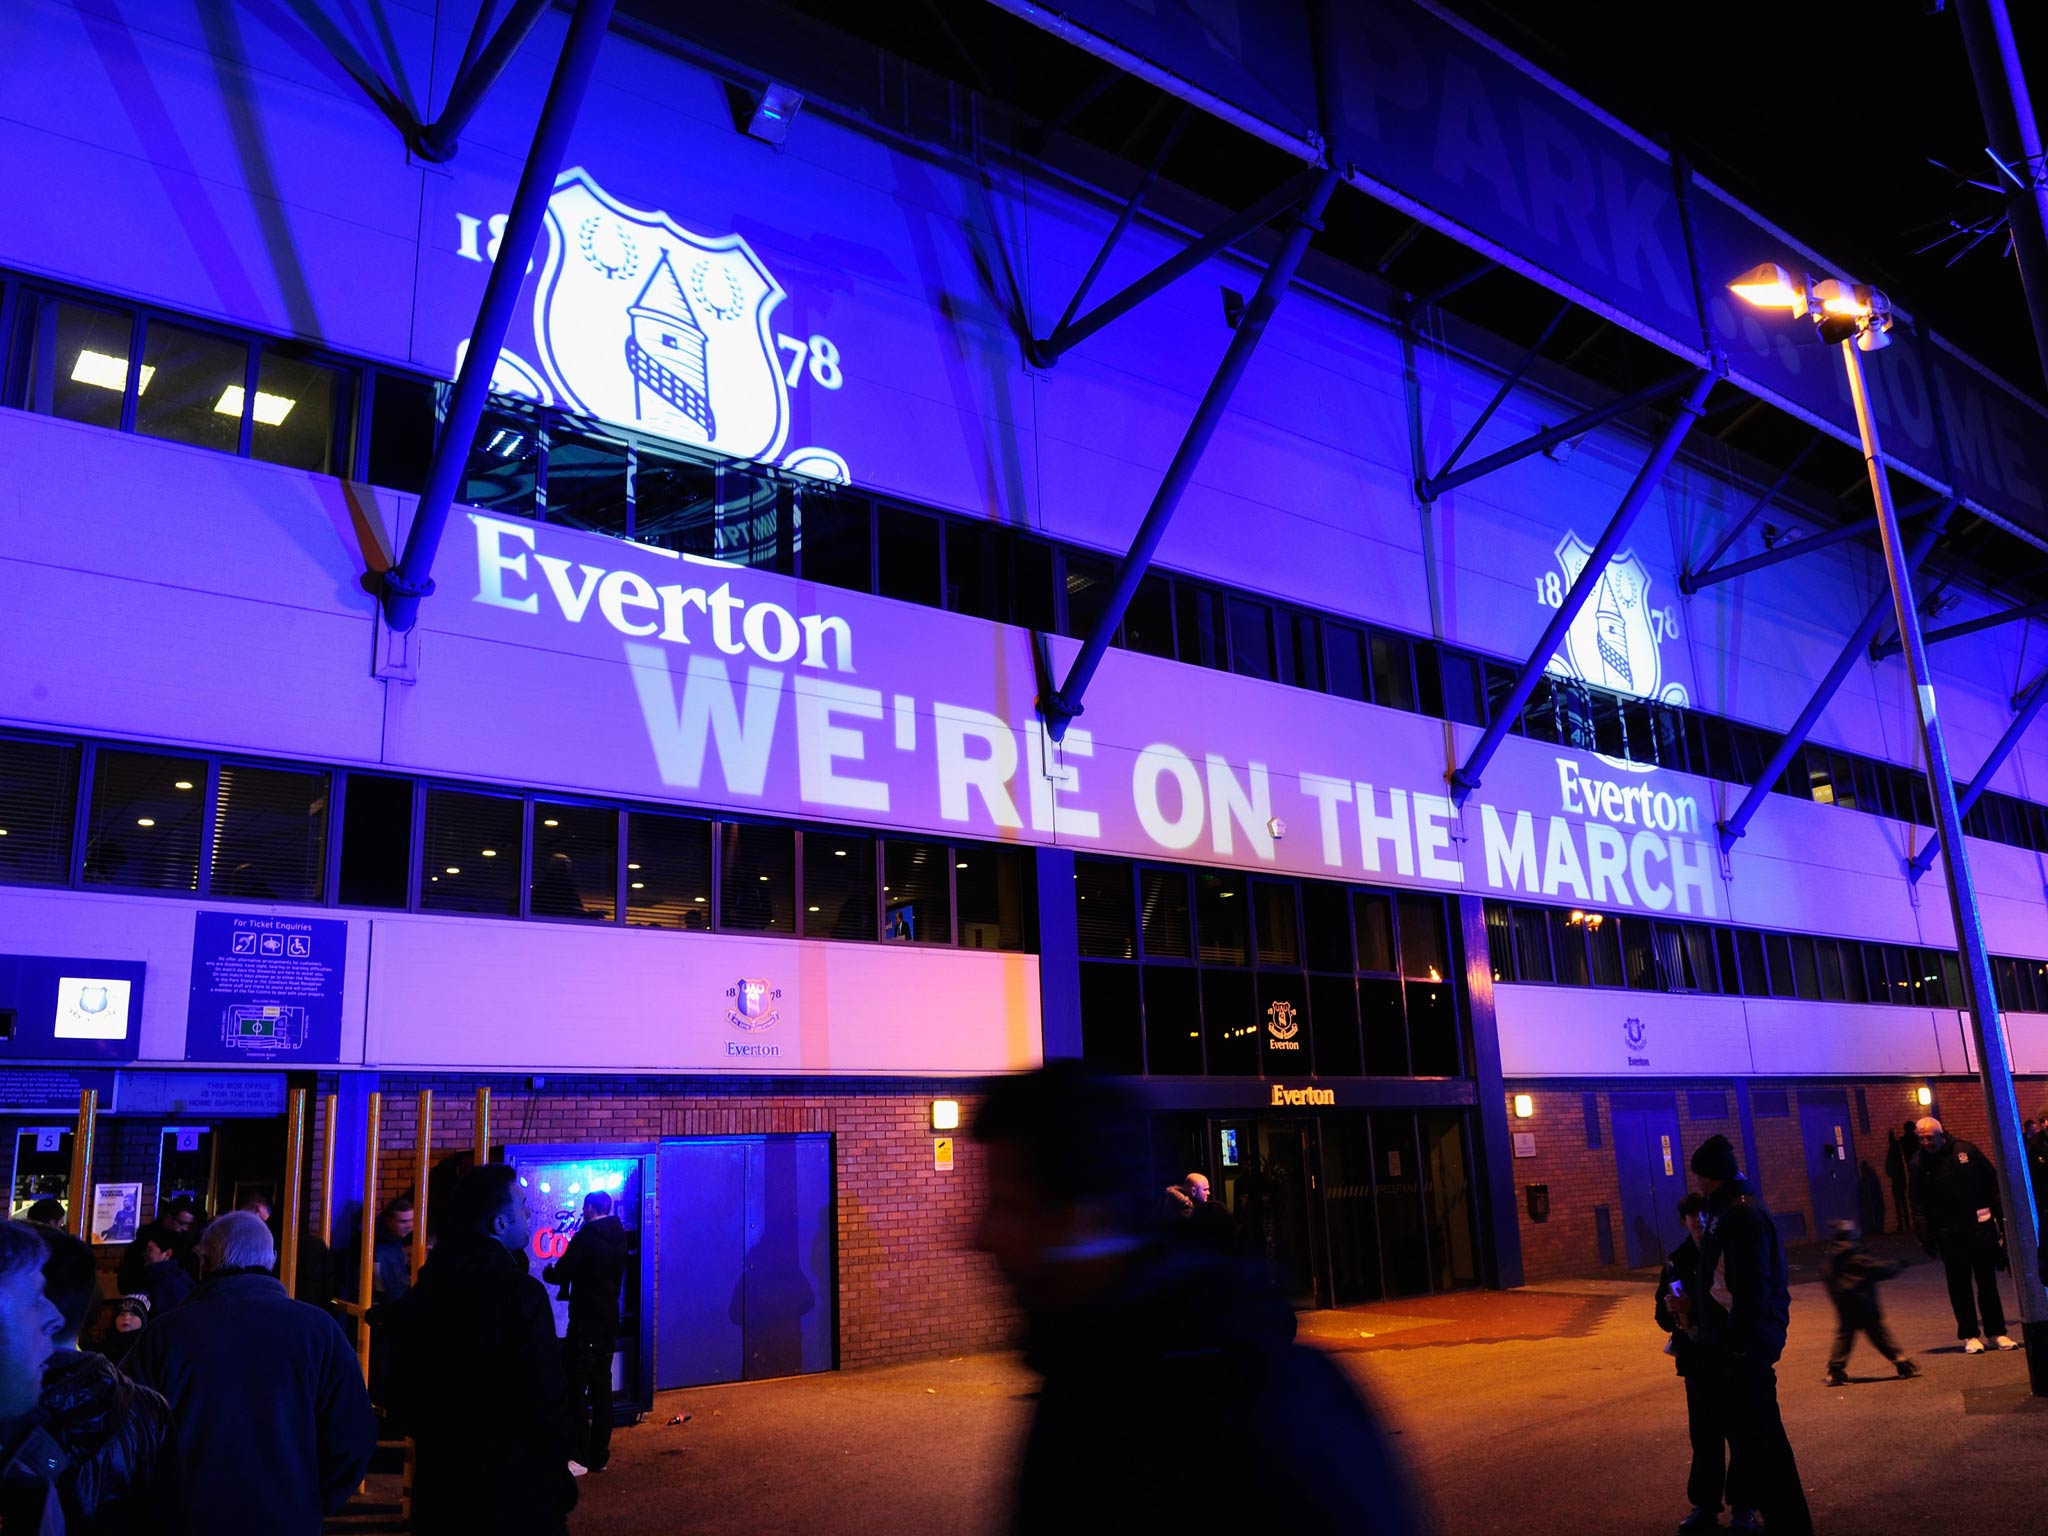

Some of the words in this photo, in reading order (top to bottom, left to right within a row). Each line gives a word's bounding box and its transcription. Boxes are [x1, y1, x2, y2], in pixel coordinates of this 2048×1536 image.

[778, 334, 843, 390] 78
[468, 513, 857, 675] Everton
[1535, 571, 1563, 609] 18
[1651, 605, 1680, 644] 78
[623, 642, 1101, 838] WE'RE
[1132, 743, 1276, 861] ON
[1300, 772, 1466, 884] THE
[1481, 804, 1718, 918] MARCH
[1555, 757, 1699, 834] Everton
[234, 919, 247, 927] For
[250, 919, 273, 930] Ticket
[275, 921, 312, 931] Enquiries
[726, 988, 736, 998] 18
[770, 989, 782, 1001] 78
[727, 1041, 780, 1057] Everton
[1269, 1038, 1300, 1051] Everton
[211, 1090, 228, 1098] FOR
[246, 1091, 261, 1099] USE
[1270, 1084, 1335, 1105] Everton
[189, 1099, 211, 1107] HOME
[214, 1100, 264, 1108] SUPPORTERS
[43, 1136, 53, 1149] 5
[183, 1135, 192, 1147] 6
